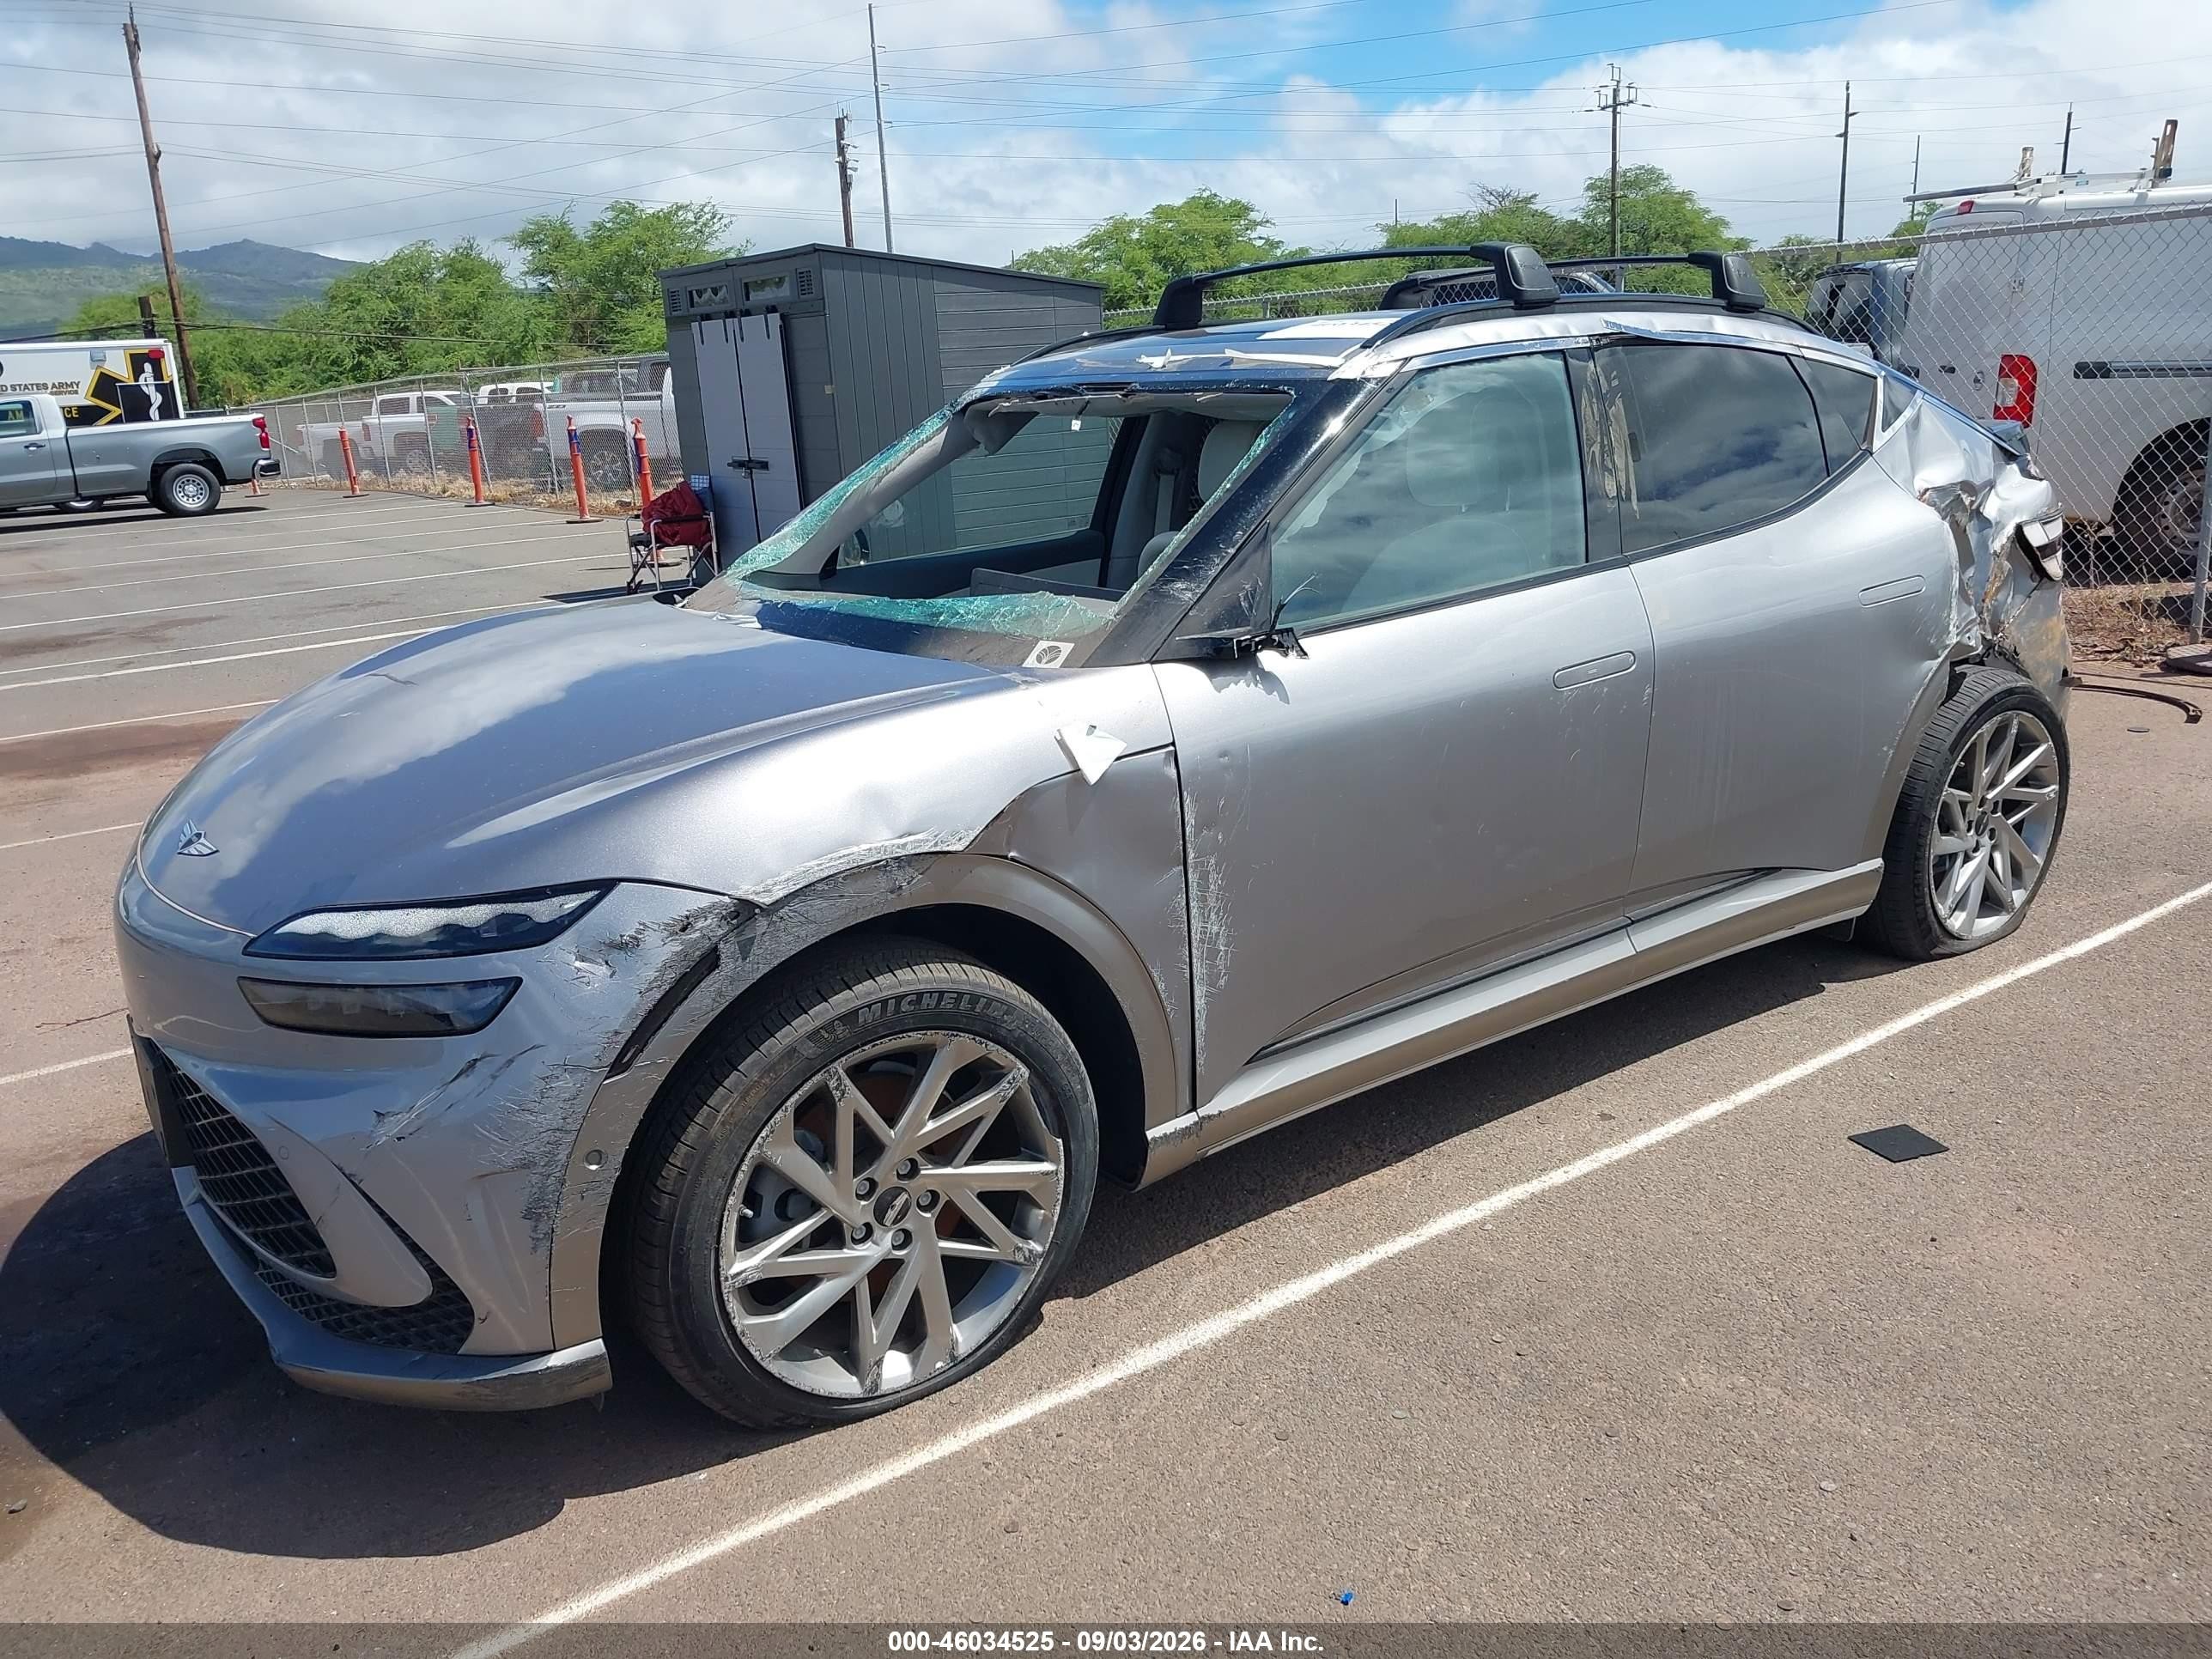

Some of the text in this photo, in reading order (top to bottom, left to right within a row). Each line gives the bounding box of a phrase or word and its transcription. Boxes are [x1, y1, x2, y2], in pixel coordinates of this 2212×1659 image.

[9, 382, 49, 392] STATES
[51, 381, 81, 390] ARMY
[858, 992, 1009, 1027] MICHELIN
